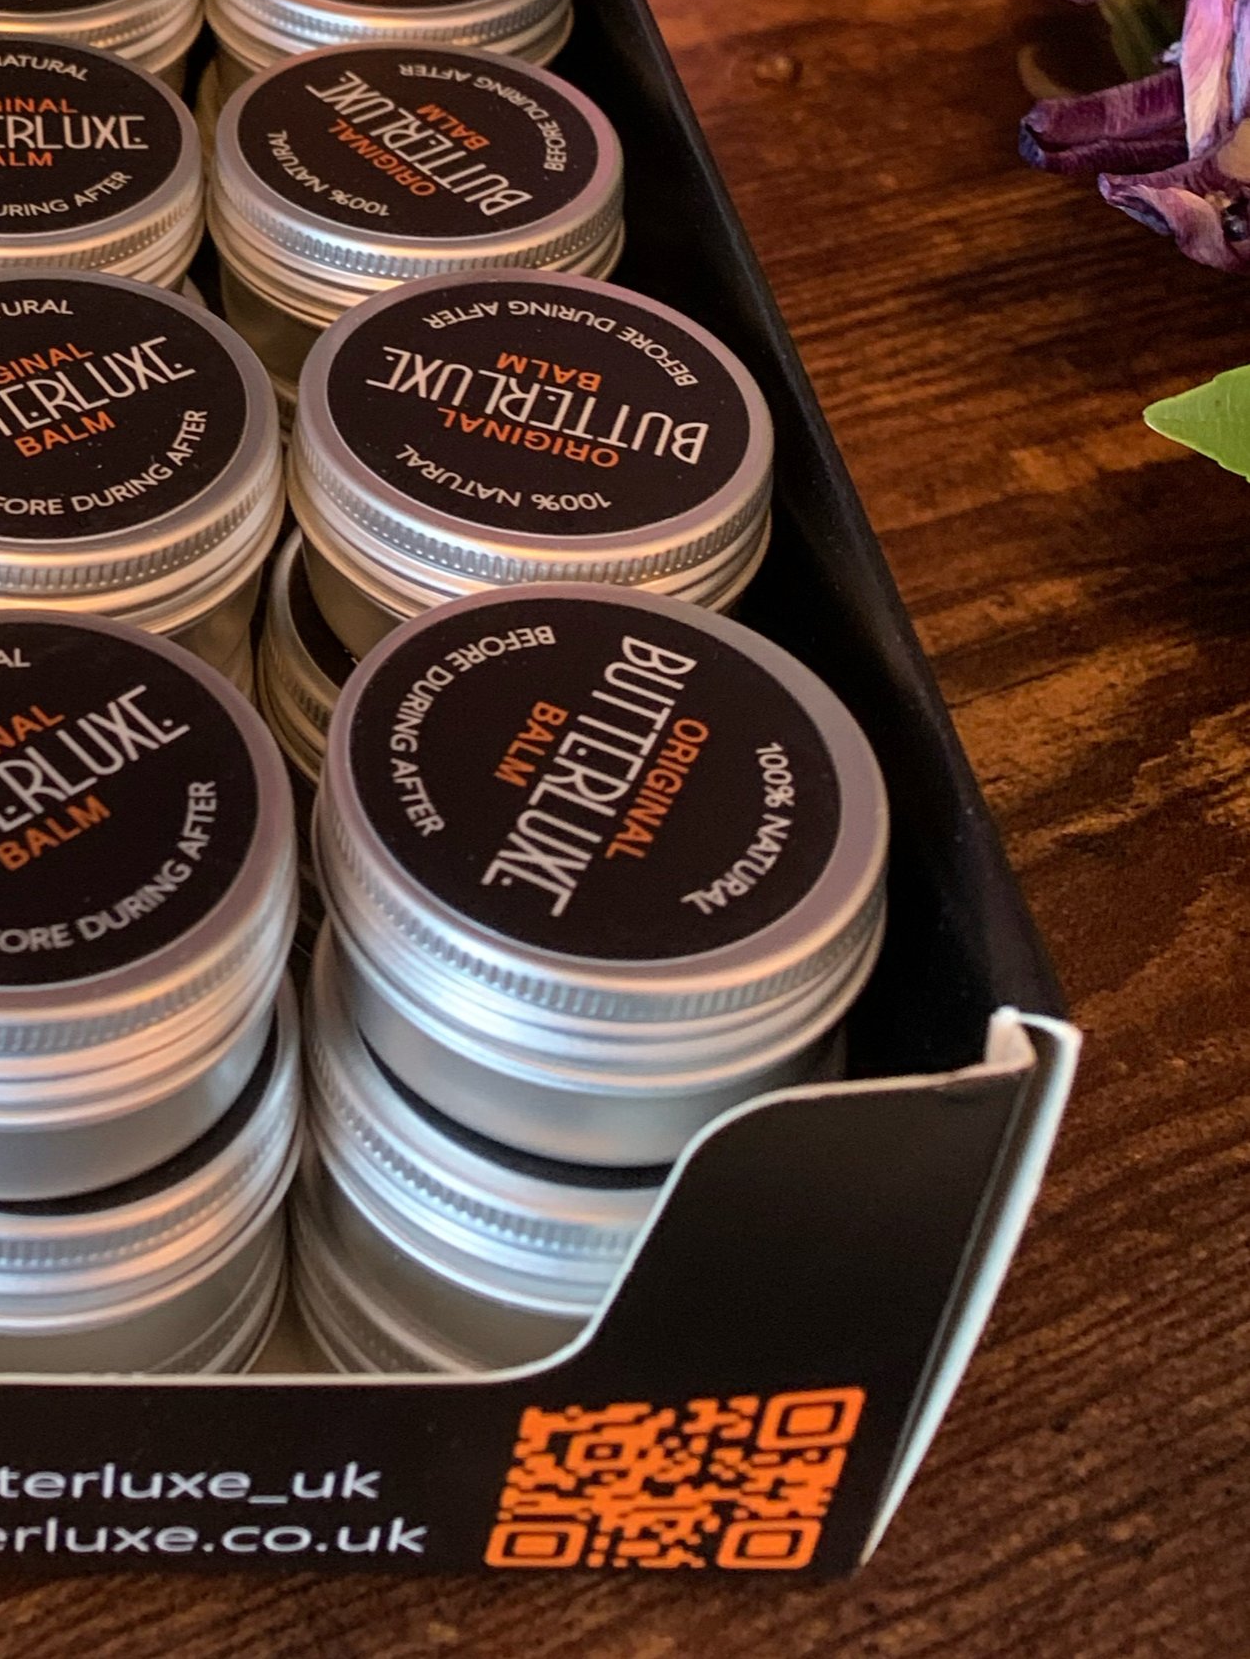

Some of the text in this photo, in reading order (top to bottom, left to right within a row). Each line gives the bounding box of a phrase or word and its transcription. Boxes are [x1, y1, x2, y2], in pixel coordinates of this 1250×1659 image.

[305, 71, 533, 217] BUTTERLUXE
[328, 119, 437, 196] ORIGINAL
[399, 64, 566, 171] BEFORE DURING AFTER
[417, 104, 489, 151] BALM
[73, 171, 132, 207] AFTER
[268, 131, 390, 217] 100% NATURAL
[423, 300, 698, 387] BEFORE DURING AFTER
[497, 353, 602, 392] BALM
[14, 412, 115, 457] BALM
[367, 346, 709, 464] BUTTERLUXE
[438, 407, 619, 468] ORIGINAL
[73, 462, 172, 512] DURING
[170, 409, 207, 467] AFTER
[395, 444, 611, 512] 100% NATURAL
[390, 625, 556, 837] BEFORE DURING AFTER
[494, 701, 568, 786] BALM
[482, 636, 697, 917] BUTTERLUXE
[605, 717, 709, 860] ORIGINAL
[78, 861, 191, 941] DURING
[183, 780, 216, 862] AFTER
[682, 742, 795, 914] 100% NATURAL
